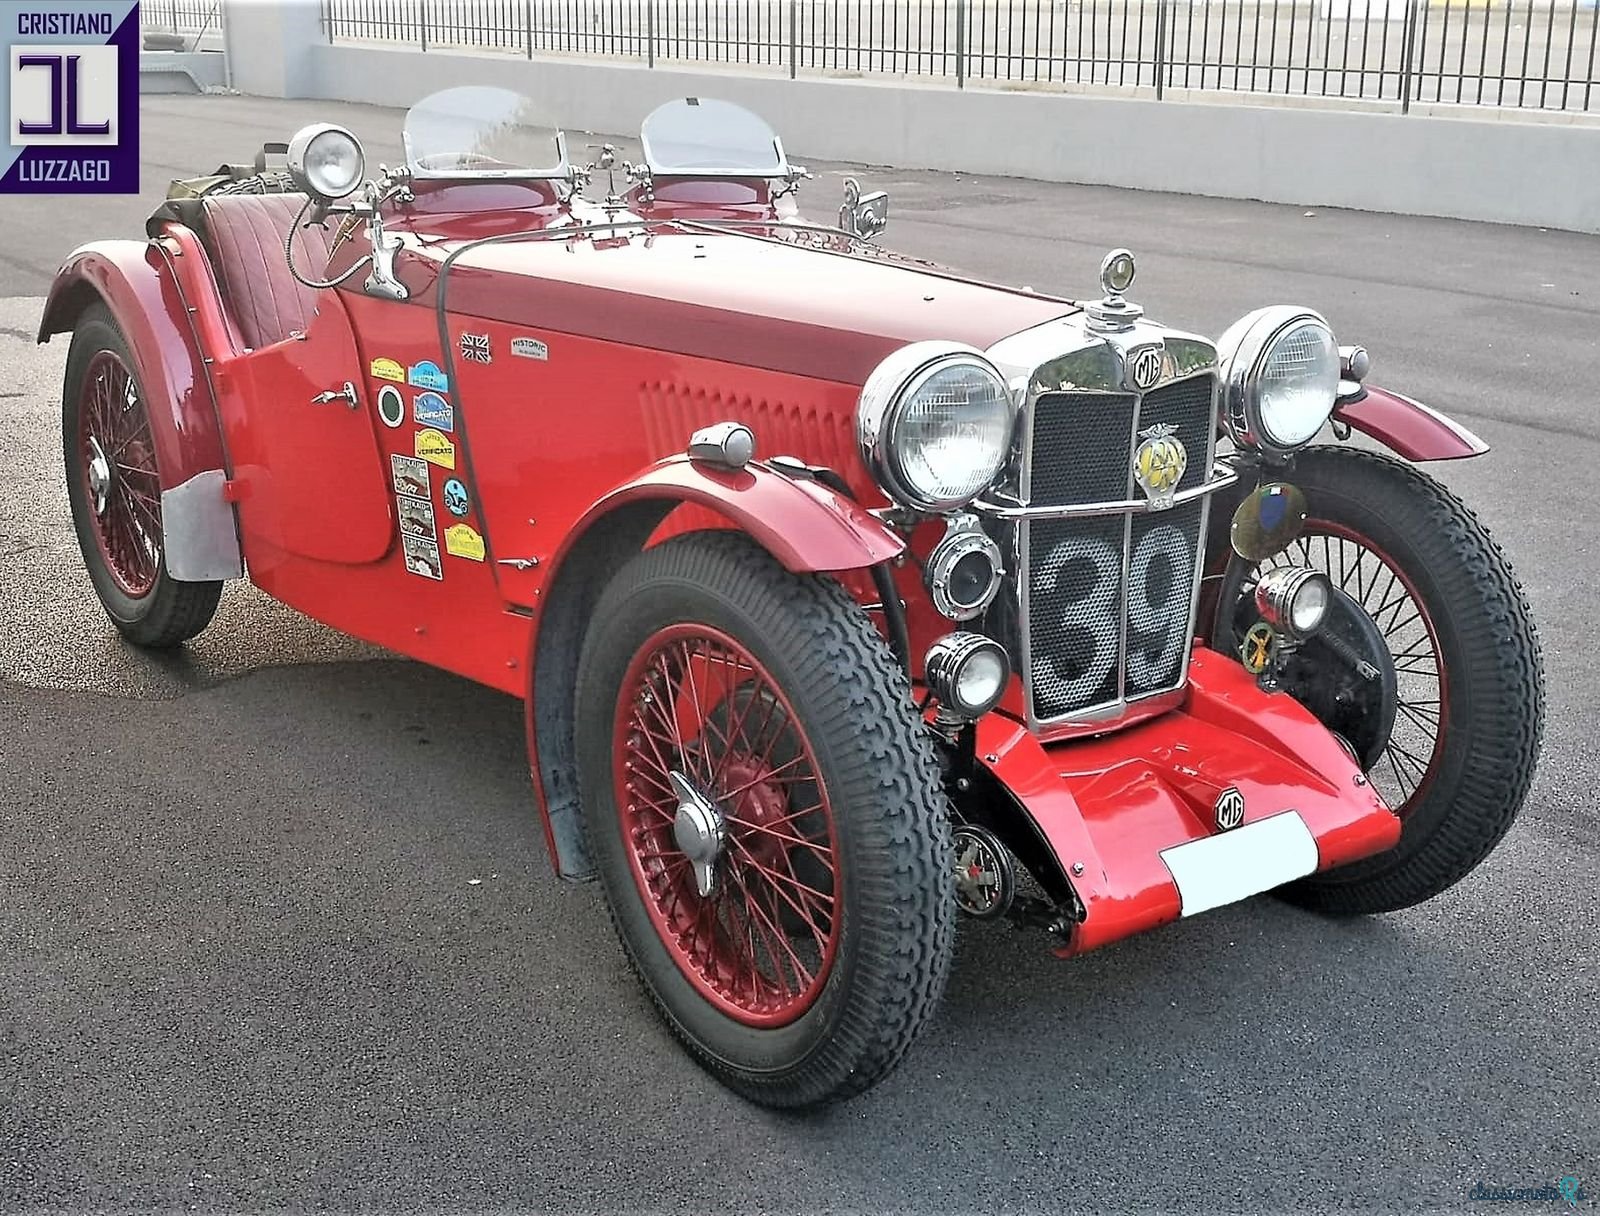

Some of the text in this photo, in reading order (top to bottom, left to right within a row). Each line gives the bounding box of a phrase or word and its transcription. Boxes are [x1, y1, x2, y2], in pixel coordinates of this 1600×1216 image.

[512, 339, 546, 353] HISTORIC
[1138, 354, 1160, 387] MG
[417, 447, 453, 456] VERIFICATO
[1033, 526, 1193, 709] 39
[1221, 796, 1242, 826] MG
